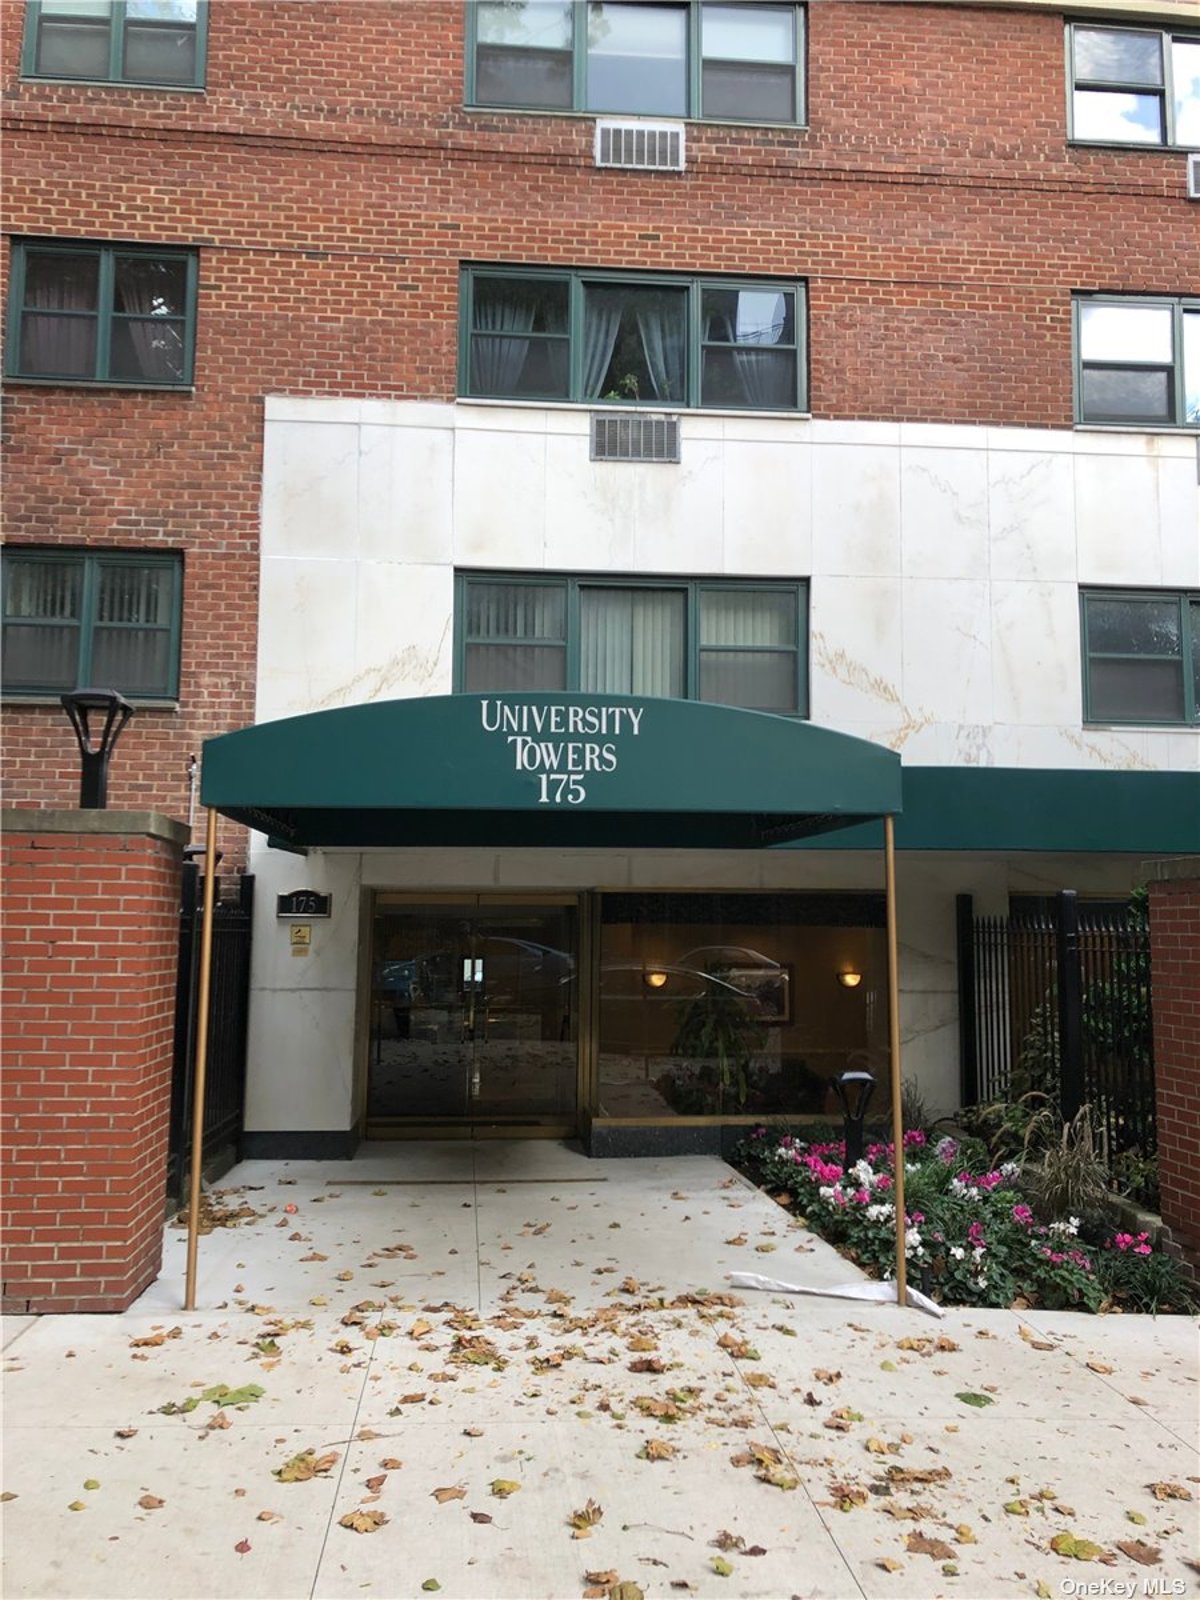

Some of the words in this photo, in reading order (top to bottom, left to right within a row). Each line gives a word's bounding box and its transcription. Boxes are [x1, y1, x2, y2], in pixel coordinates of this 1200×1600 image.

[481, 699, 644, 736] UNIVERSITY
[507, 735, 617, 772] TOWERS
[538, 773, 586, 804] 175
[291, 896, 317, 913] 175
